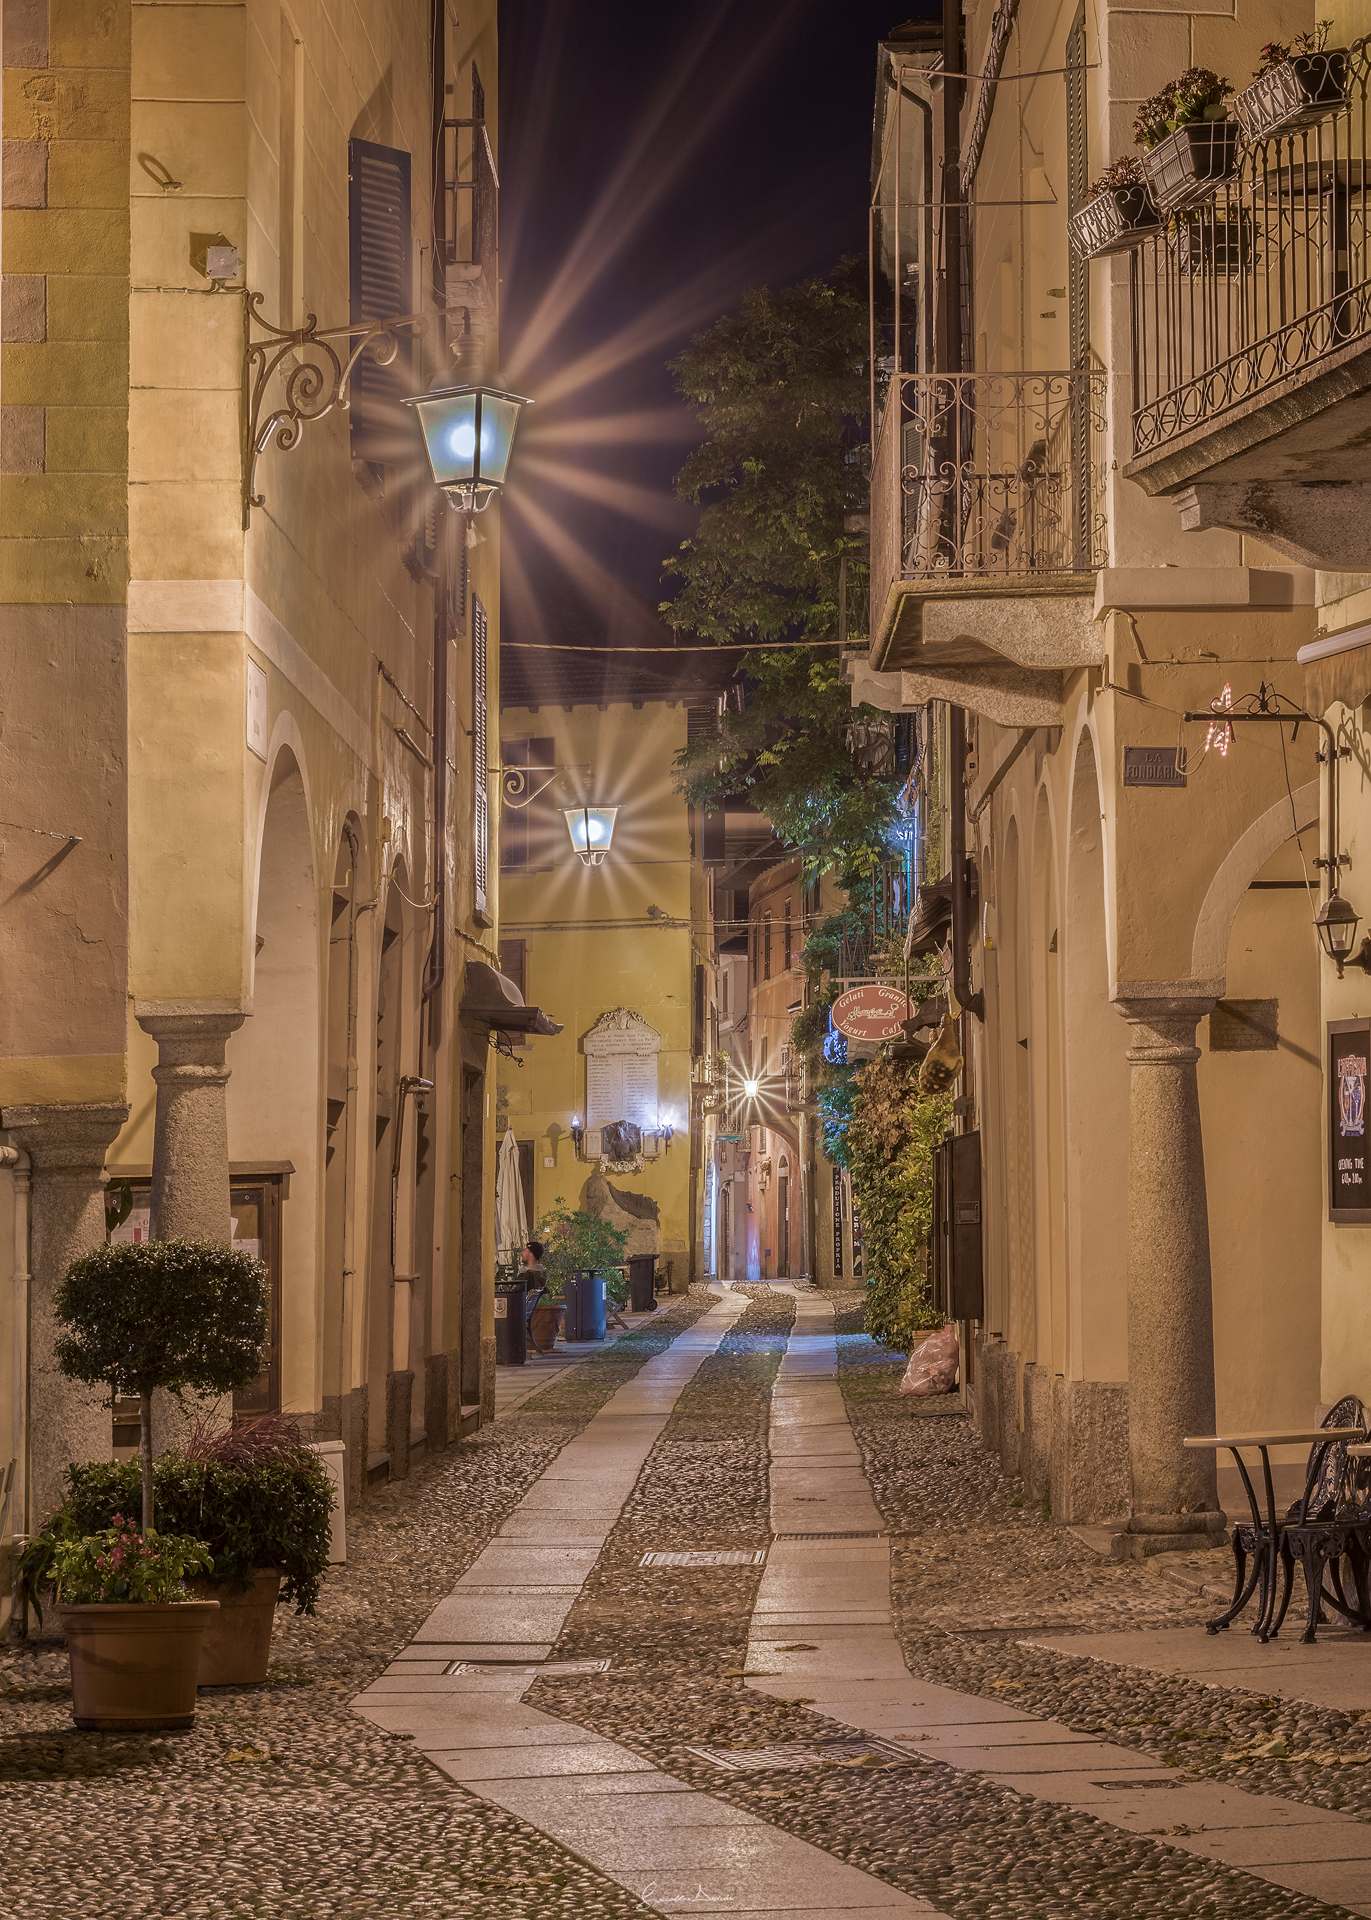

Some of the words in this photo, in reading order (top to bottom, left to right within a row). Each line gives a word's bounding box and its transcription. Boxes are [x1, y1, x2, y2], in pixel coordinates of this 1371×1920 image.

[1145, 753, 1163, 763] LA
[1127, 765, 1183, 779] FONDIARIA
[839, 989, 864, 1007] Gelati
[840, 1019, 867, 1036] Yogurt
[881, 1021, 901, 1036] Caff
